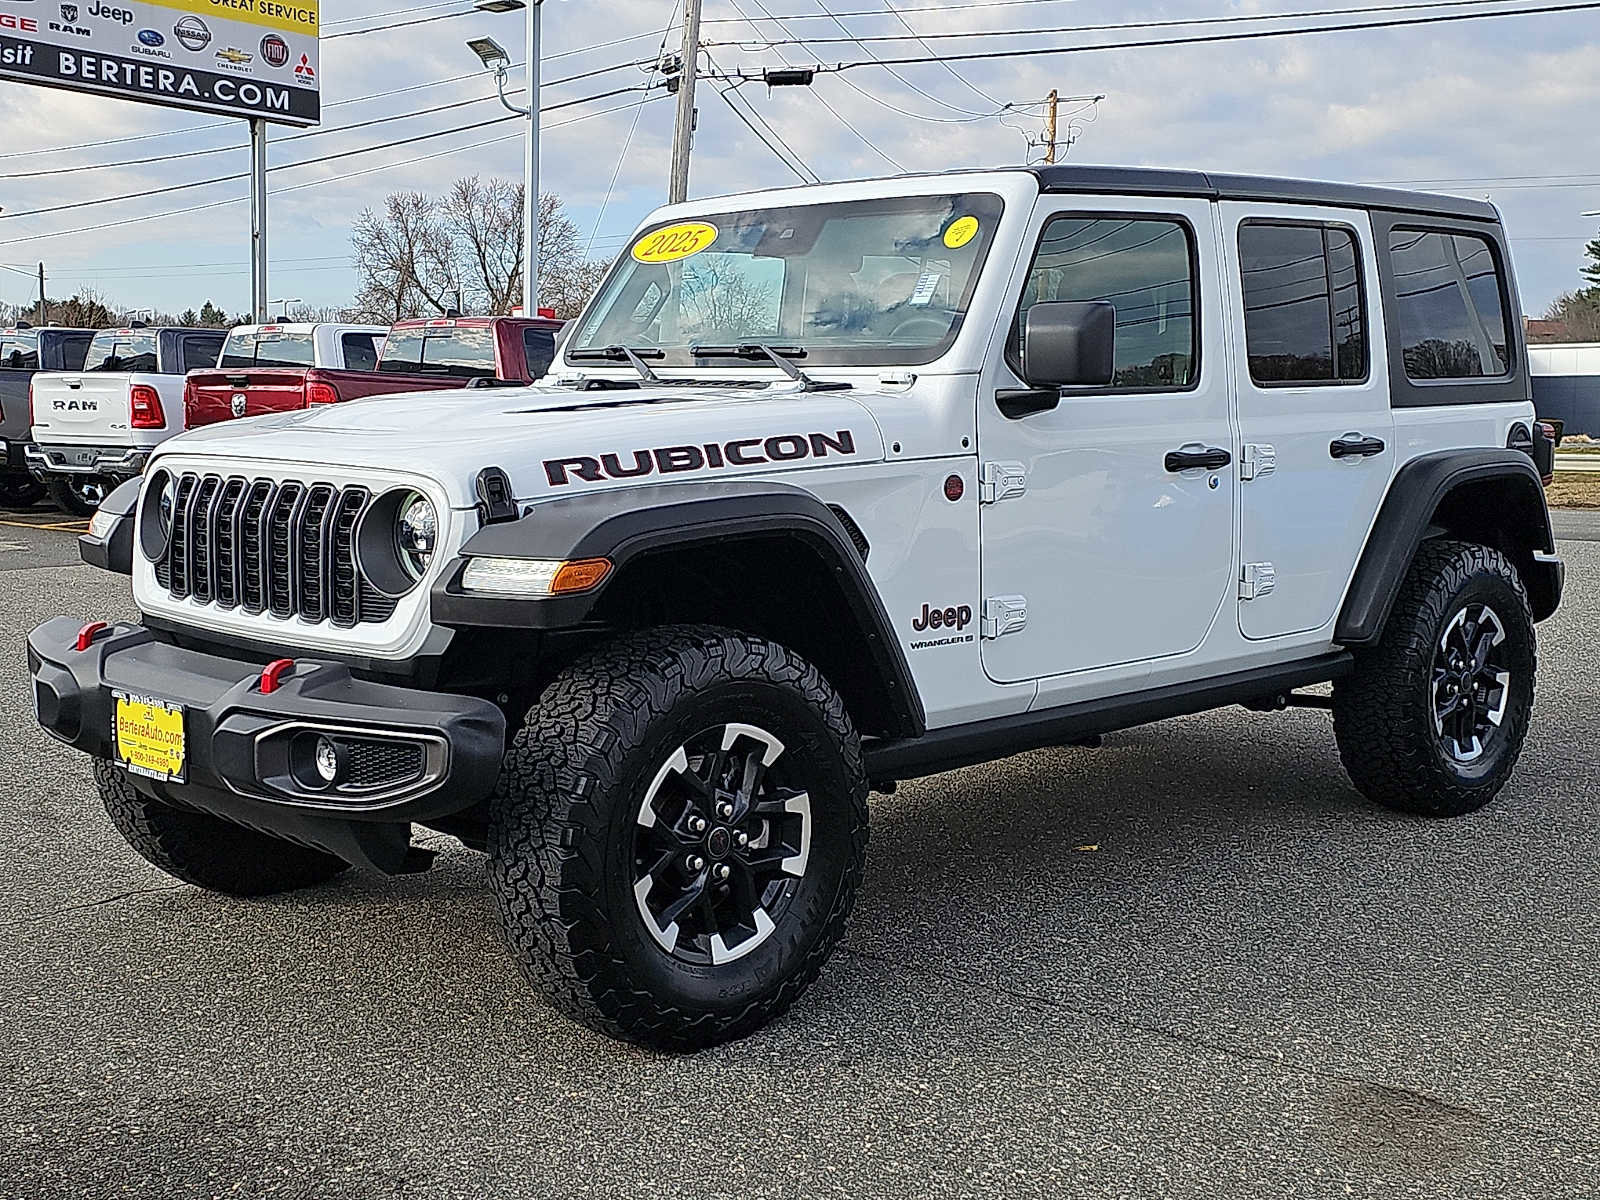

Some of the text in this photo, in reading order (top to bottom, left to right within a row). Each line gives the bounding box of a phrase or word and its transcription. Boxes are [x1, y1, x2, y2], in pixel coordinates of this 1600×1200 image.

[88, 1, 133, 25] Jeep
[259, 2, 316, 25] SERVICE
[48, 22, 91, 36] RAM
[177, 28, 208, 41] NISSAN
[131, 46, 171, 58] SUBARU
[267, 43, 283, 60] FIAT
[0, 42, 290, 111] sit BERTERA.COM
[217, 62, 253, 72] CHEVROLET
[641, 229, 708, 257] 2025
[52, 400, 98, 411] RAM
[542, 429, 856, 486] RUBICON
[912, 603, 972, 632] Jeep
[910, 636, 964, 650] WRANGLER
[119, 715, 182, 747] BerteraAuto.com
